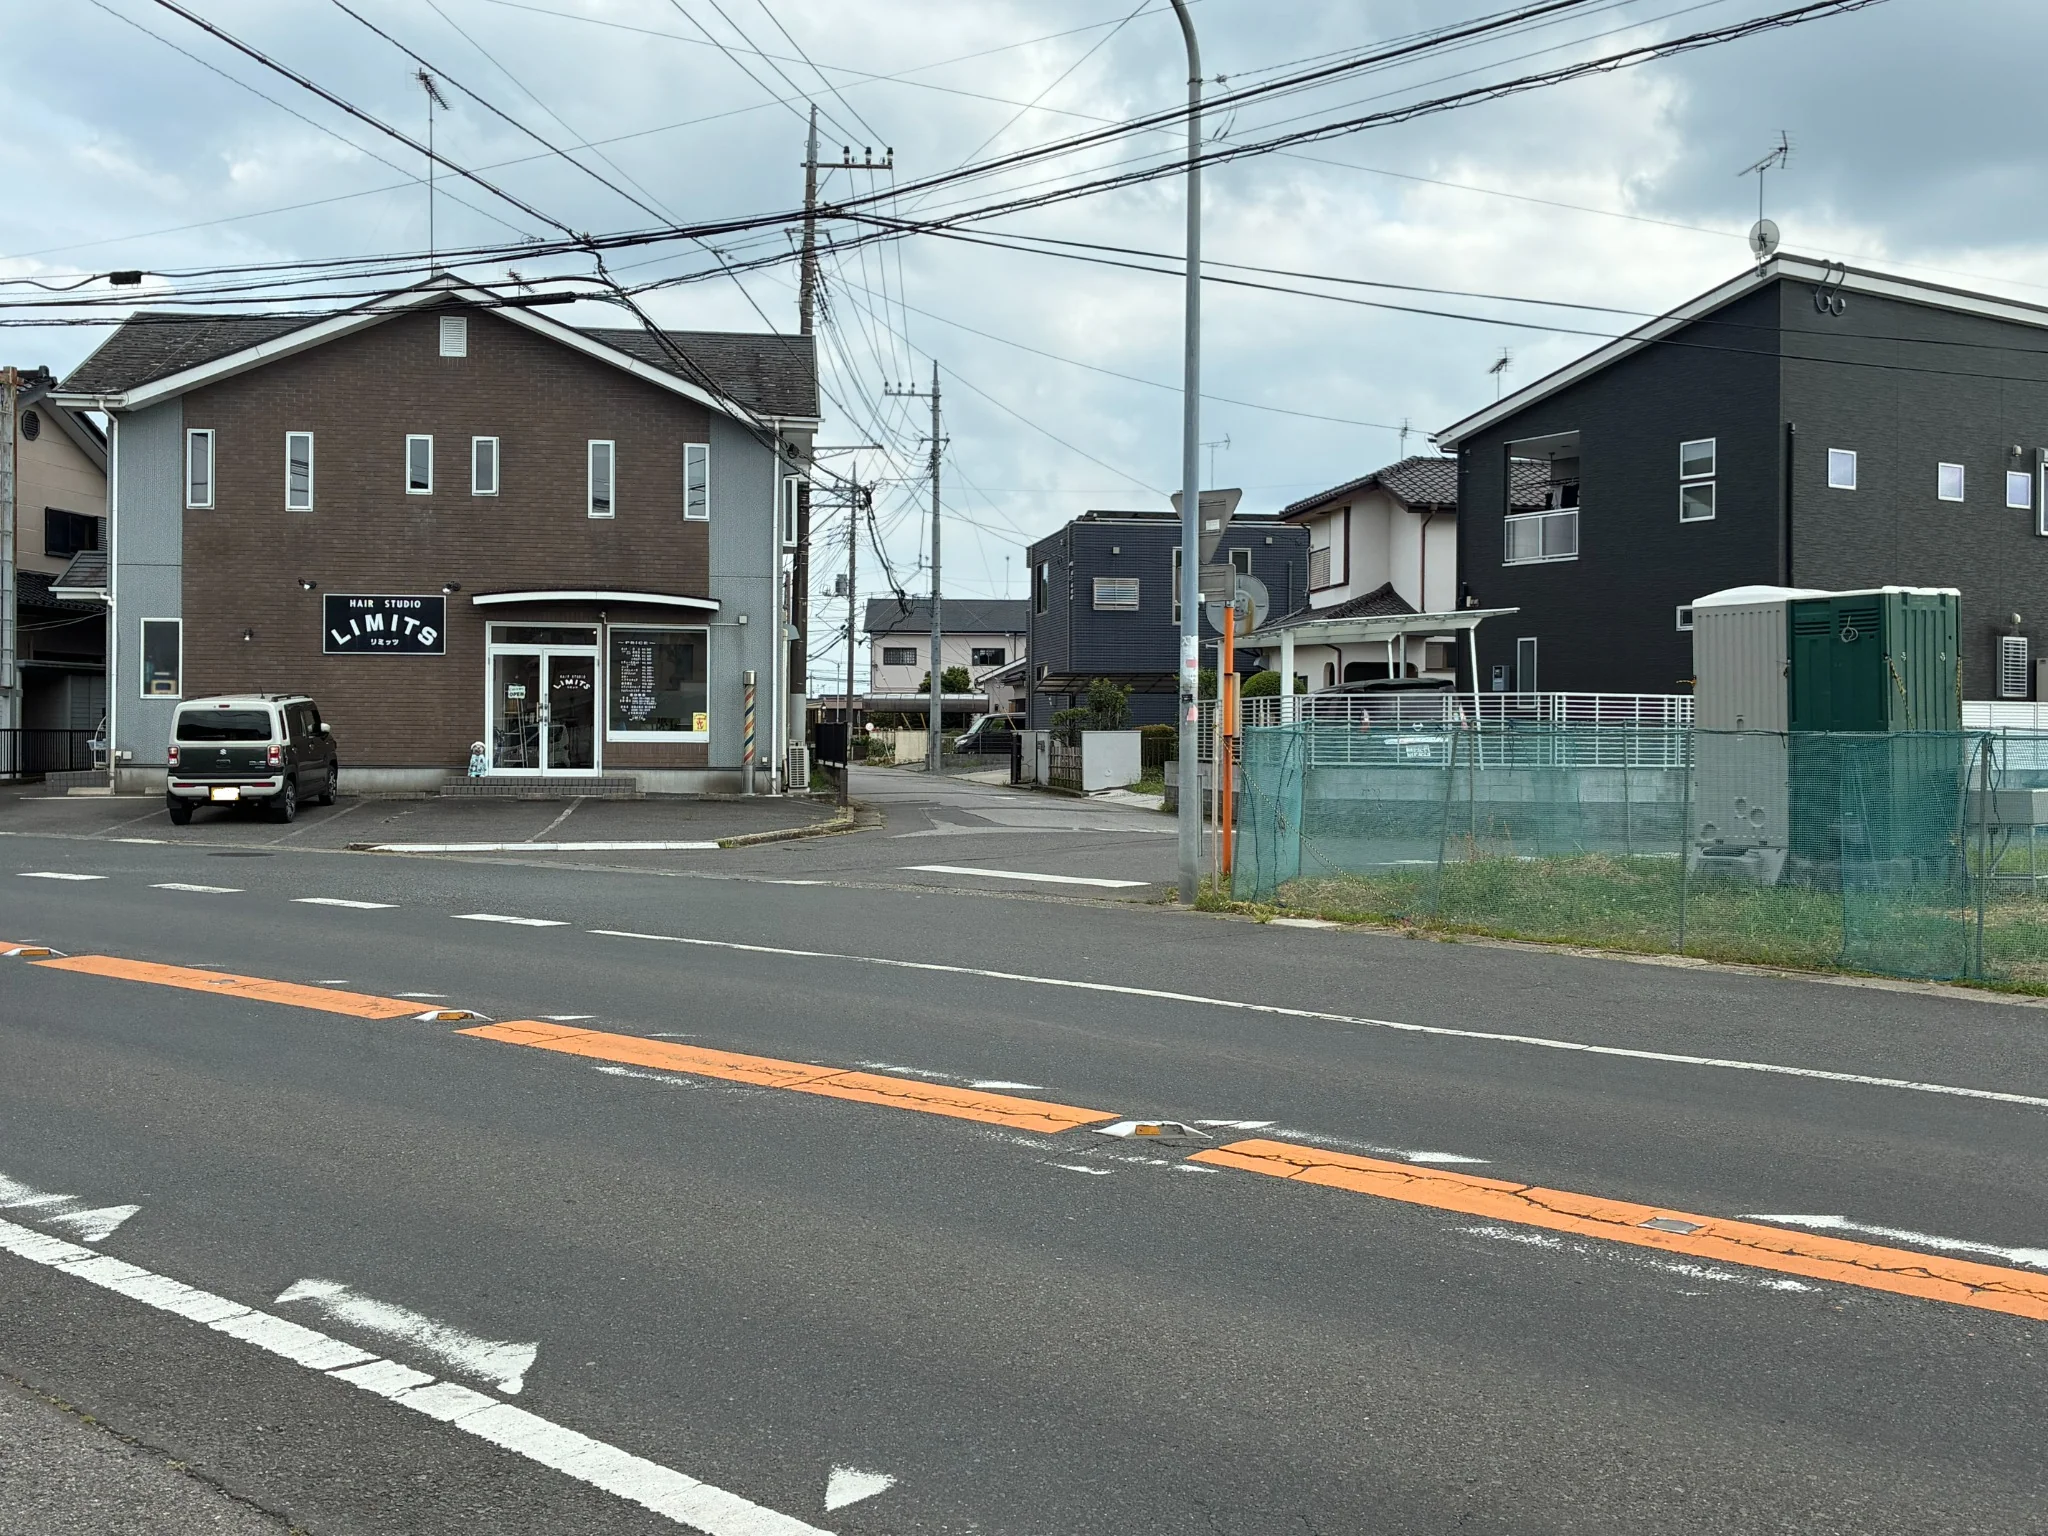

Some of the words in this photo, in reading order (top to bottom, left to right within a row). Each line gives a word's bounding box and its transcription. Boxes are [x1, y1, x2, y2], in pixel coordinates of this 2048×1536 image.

[349, 599, 374, 608] HAIR
[385, 599, 421, 608] STUDIO
[331, 613, 438, 646] LIMITS
[370, 638, 399, 646] リミッツ
[553, 679, 591, 690] LIMITS
